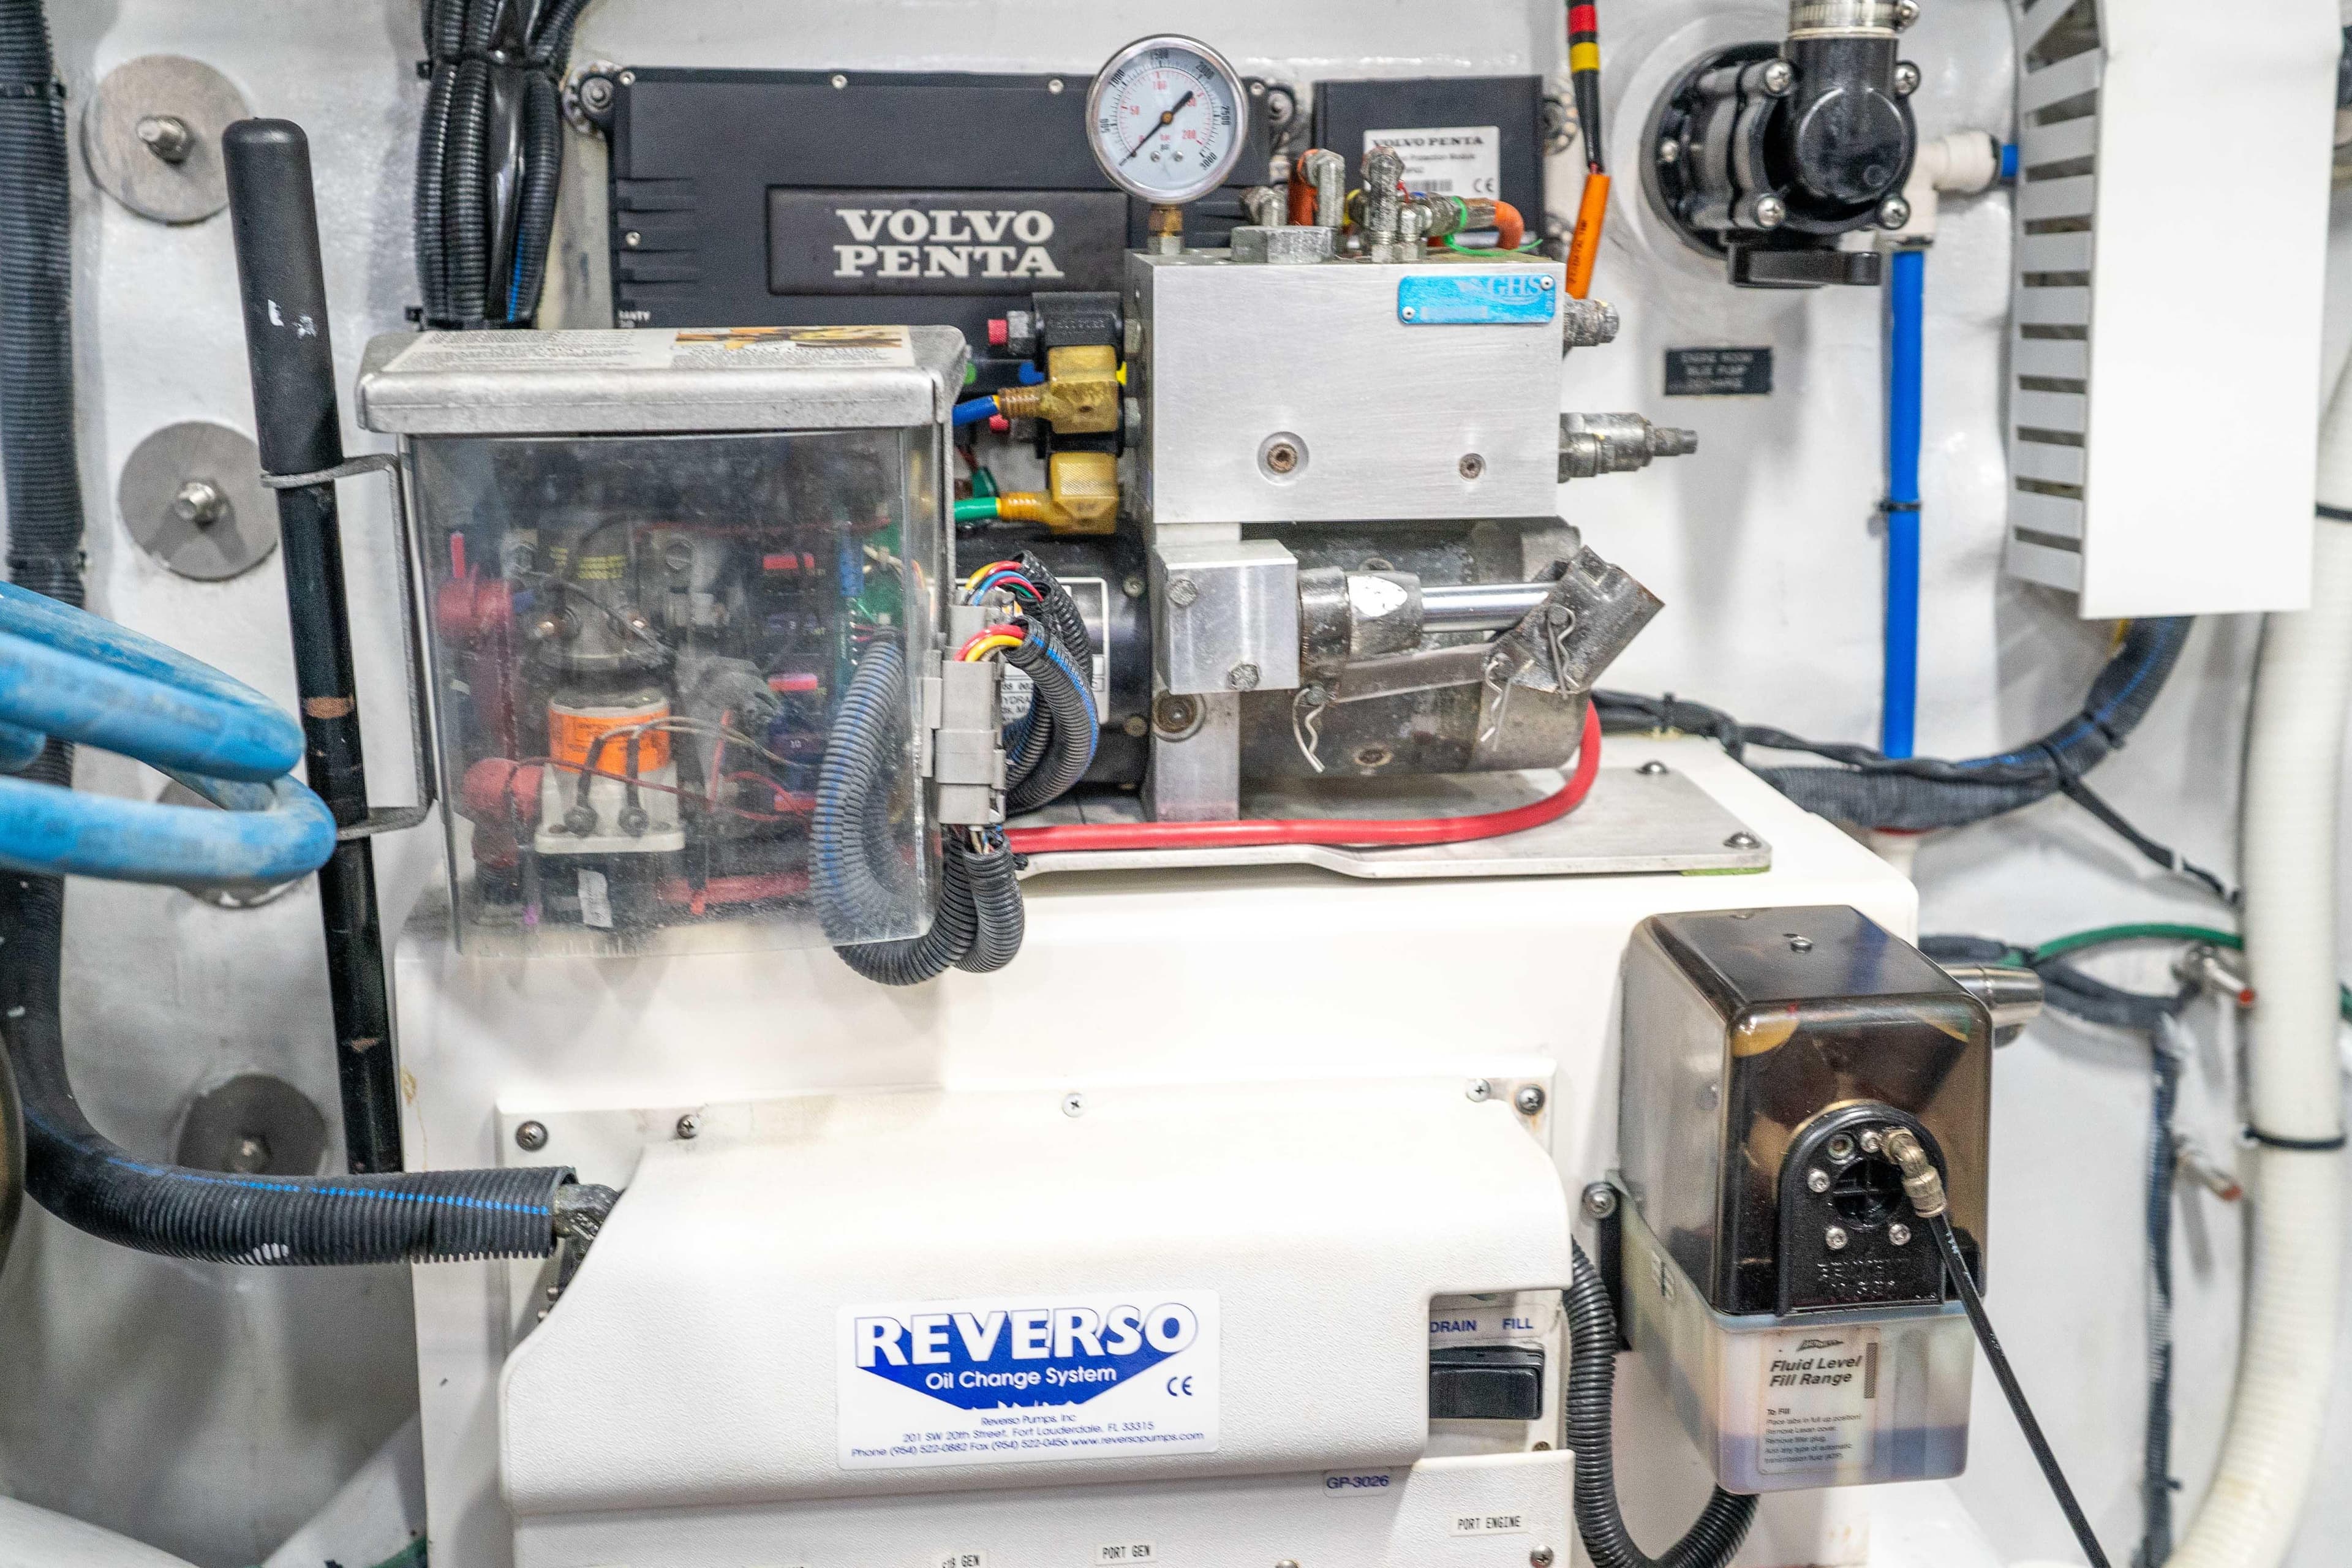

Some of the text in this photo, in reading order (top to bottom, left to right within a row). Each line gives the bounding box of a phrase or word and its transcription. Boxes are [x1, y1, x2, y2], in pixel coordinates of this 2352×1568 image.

[1109, 69, 1125, 88] 1000
[1221, 105, 1231, 126] 2500
[1373, 136, 1483, 147] VOLVO PENTA
[1199, 153, 1217, 170] 3000
[835, 209, 1054, 243] VOLVO
[833, 245, 1065, 277] PENTA
[1430, 1317, 1533, 1333] DRAIN FILL
[854, 1302, 1199, 1368] REVERSO
[1770, 1355, 1863, 1372] Fluid Level
[925, 1365, 1117, 1390] Oil Change System
[1166, 1376, 1193, 1396] CE
[1769, 1373, 1852, 1387] Fill Range
[981, 1417, 1020, 1426] Reverso
[903, 1433, 921, 1442] 201
[925, 1432, 943, 1441] SW
[946, 1431, 970, 1440] 20th
[1012, 1428, 1033, 1436] Fort
[1122, 1421, 1155, 1431] 33315
[851, 1447, 888, 1457] Phone
[970, 1442, 989, 1450] Fax
[1071, 1431, 1205, 1446] www.reversopumps.com
[1327, 1475, 1389, 1489] GP-3026
[1458, 1515, 1521, 1530] PORT ENGINE
[1102, 1544, 1151, 1559] PORT GEN
[961, 1555, 980, 1567] GEN
